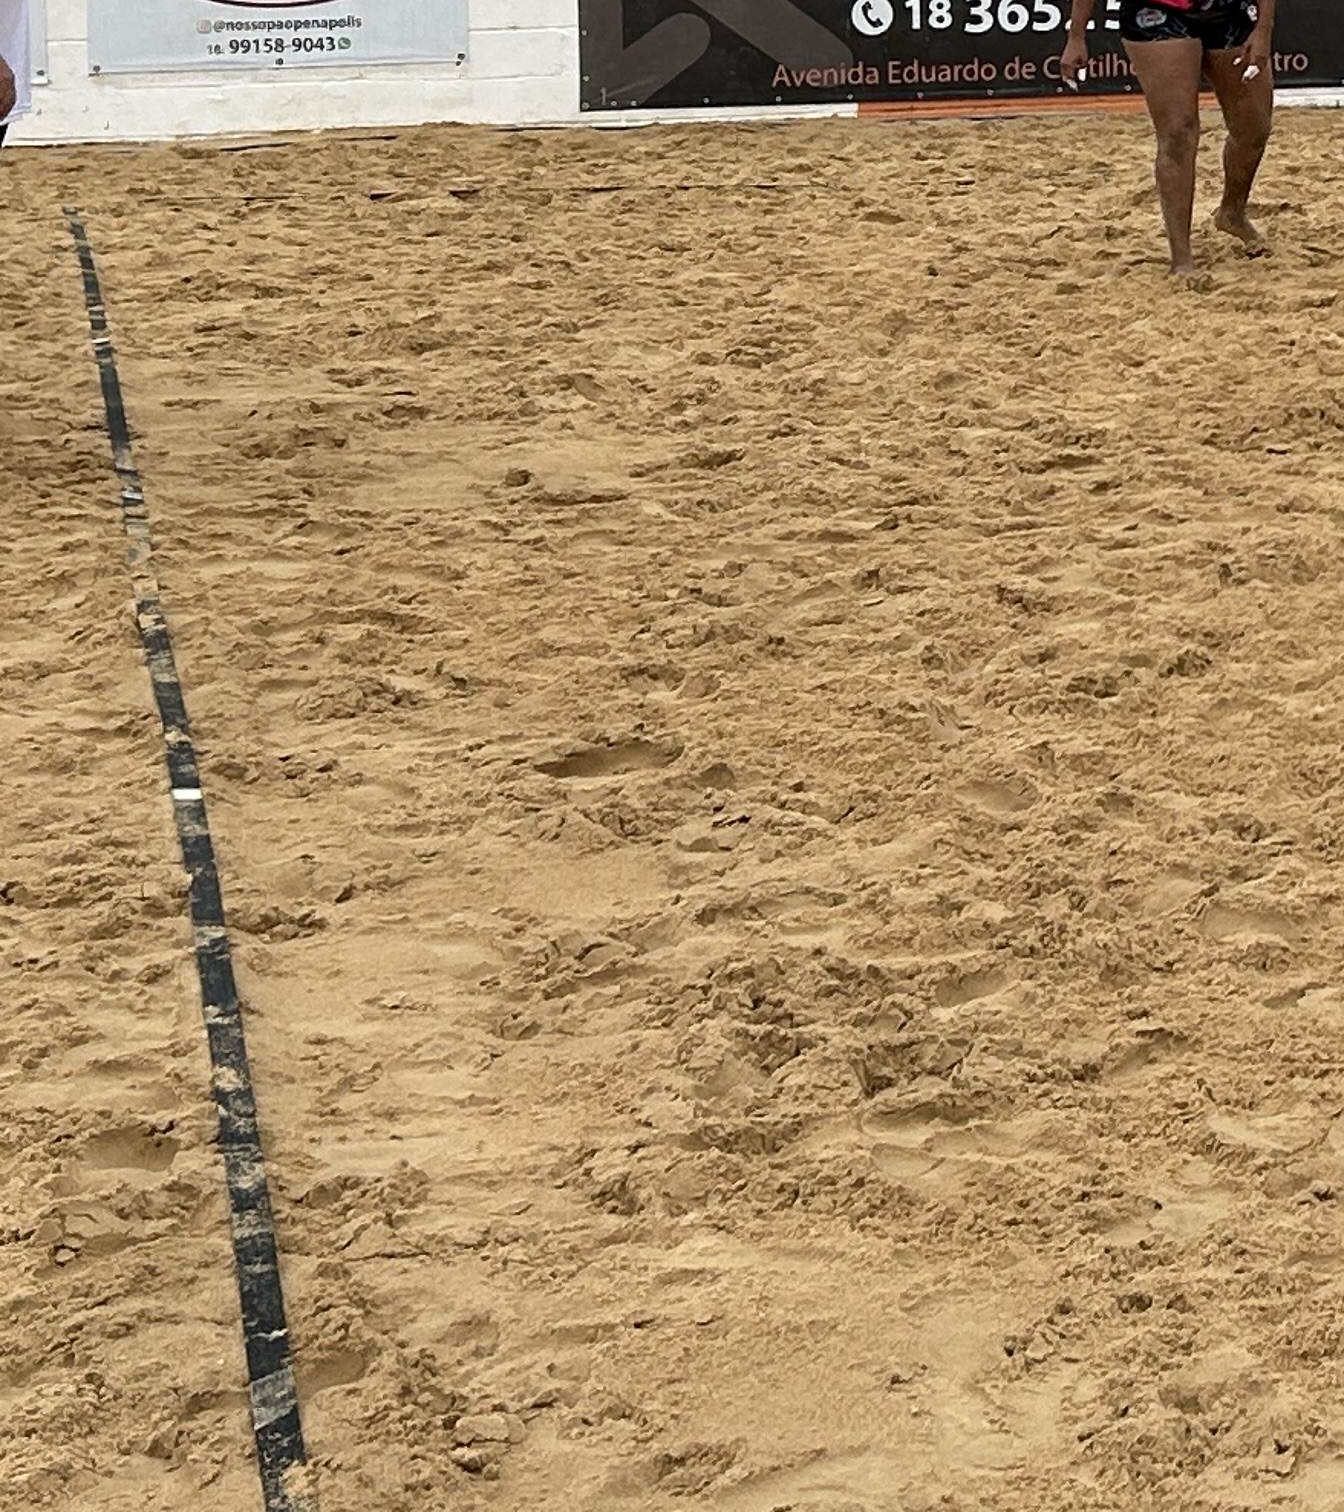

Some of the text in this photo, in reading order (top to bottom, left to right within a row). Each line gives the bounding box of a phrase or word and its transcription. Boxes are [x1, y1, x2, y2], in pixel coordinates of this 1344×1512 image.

[229, 36, 337, 56] 99158-9043
[772, 51, 1309, 88] Avenida Eduardo de Ctilh tro
